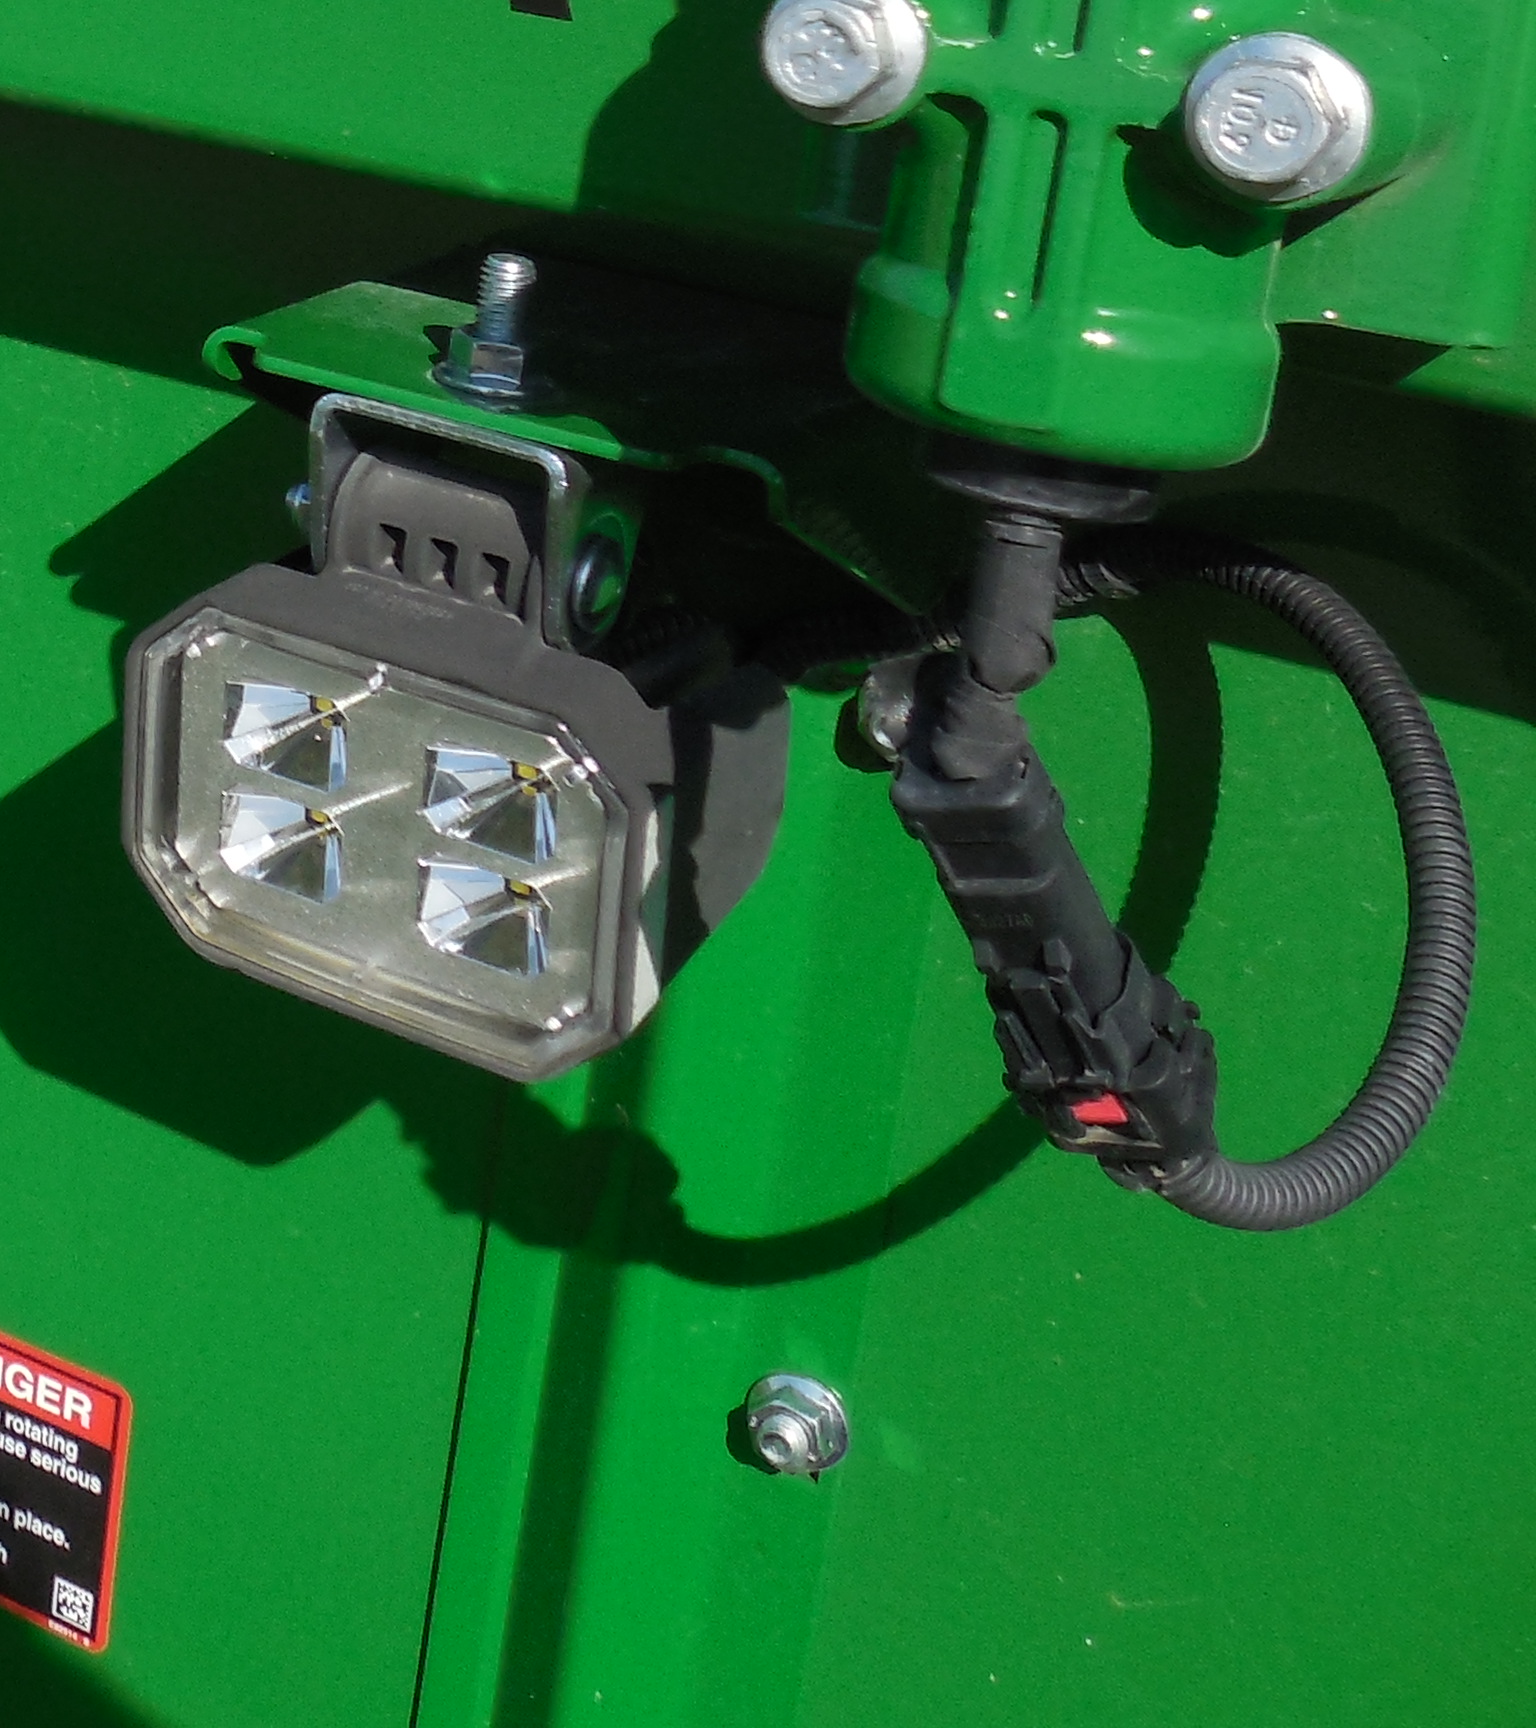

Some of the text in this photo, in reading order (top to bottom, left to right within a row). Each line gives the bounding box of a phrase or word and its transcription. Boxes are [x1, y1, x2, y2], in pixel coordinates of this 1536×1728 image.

[5, 1412, 78, 1464] rotating
[31, 1448, 102, 1497] serious
[14, 1507, 71, 1552] place.
